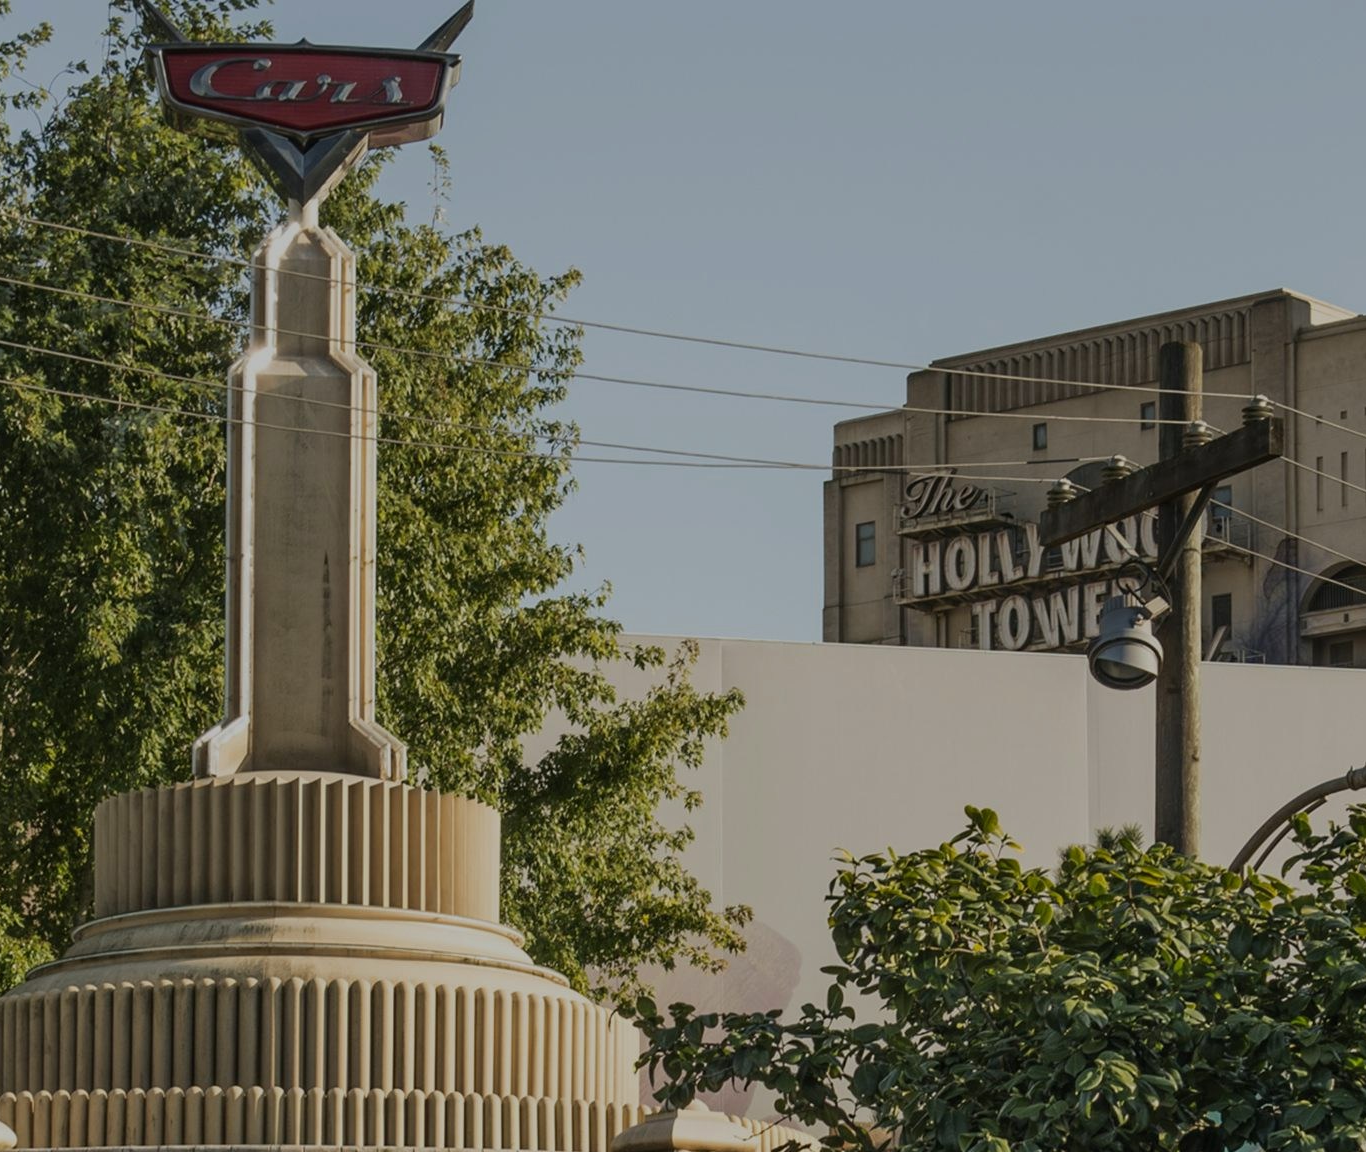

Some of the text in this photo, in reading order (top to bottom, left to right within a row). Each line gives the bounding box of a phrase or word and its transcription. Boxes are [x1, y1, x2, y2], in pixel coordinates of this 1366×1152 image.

[189, 57, 414, 105] Cars
[900, 468, 984, 519] The
[912, 505, 1208, 597] HOLLYWOO
